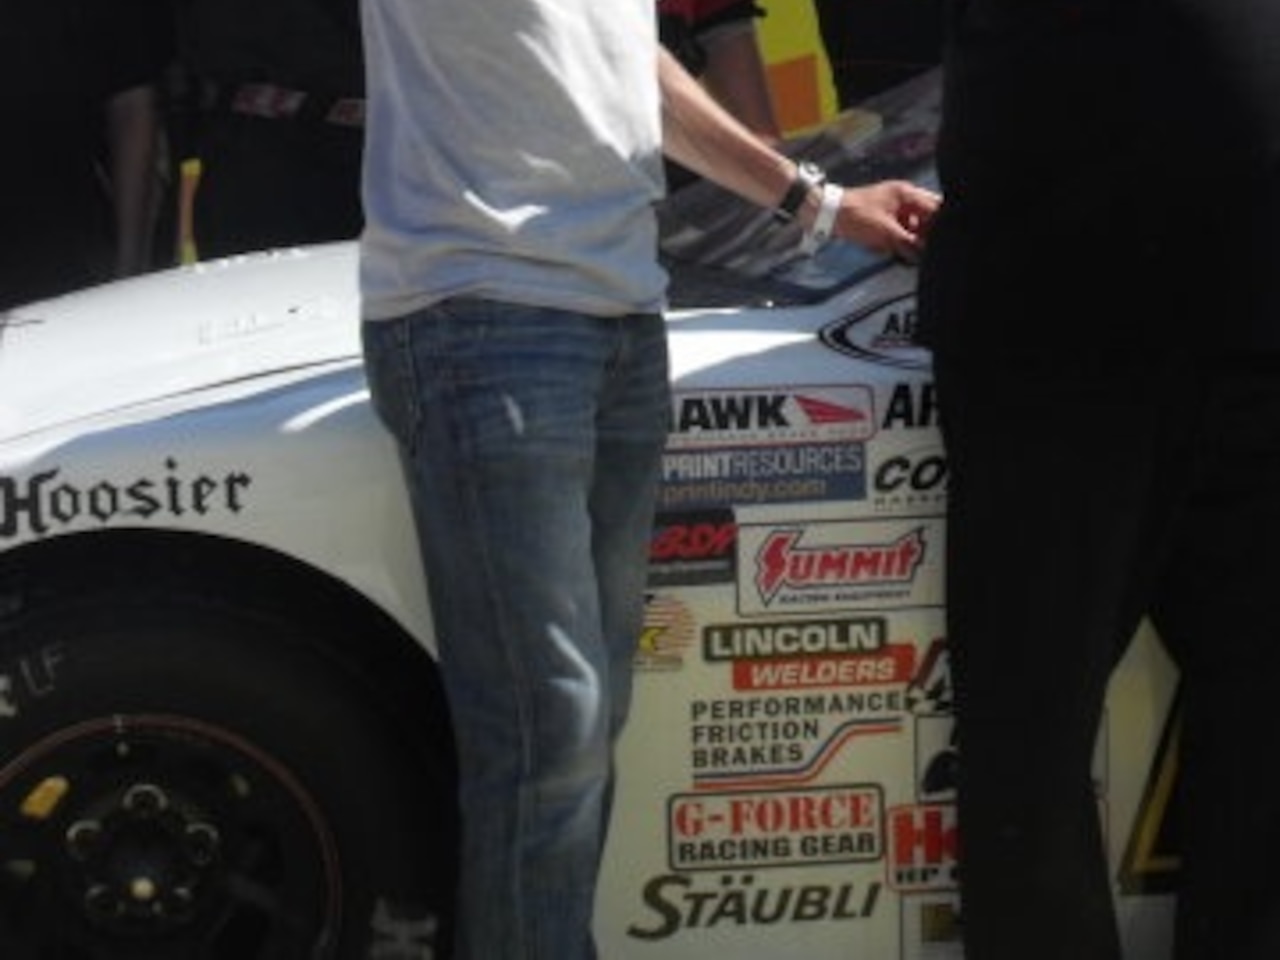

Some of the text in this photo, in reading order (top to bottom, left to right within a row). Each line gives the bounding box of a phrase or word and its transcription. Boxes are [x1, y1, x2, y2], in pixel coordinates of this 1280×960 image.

[678, 394, 791, 431] AWK
[0, 456, 252, 537] Hoosier
[710, 623, 879, 657] LINCOLN
[751, 657, 895, 686] WELDERS
[692, 692, 902, 720] PERFORMANCE
[692, 720, 820, 745] FRICTION
[693, 743, 803, 768] BRAKES
[675, 794, 874, 837] G-FORCE
[678, 833, 875, 862] RACING GEAR
[626, 874, 882, 943] STÄUBLI
